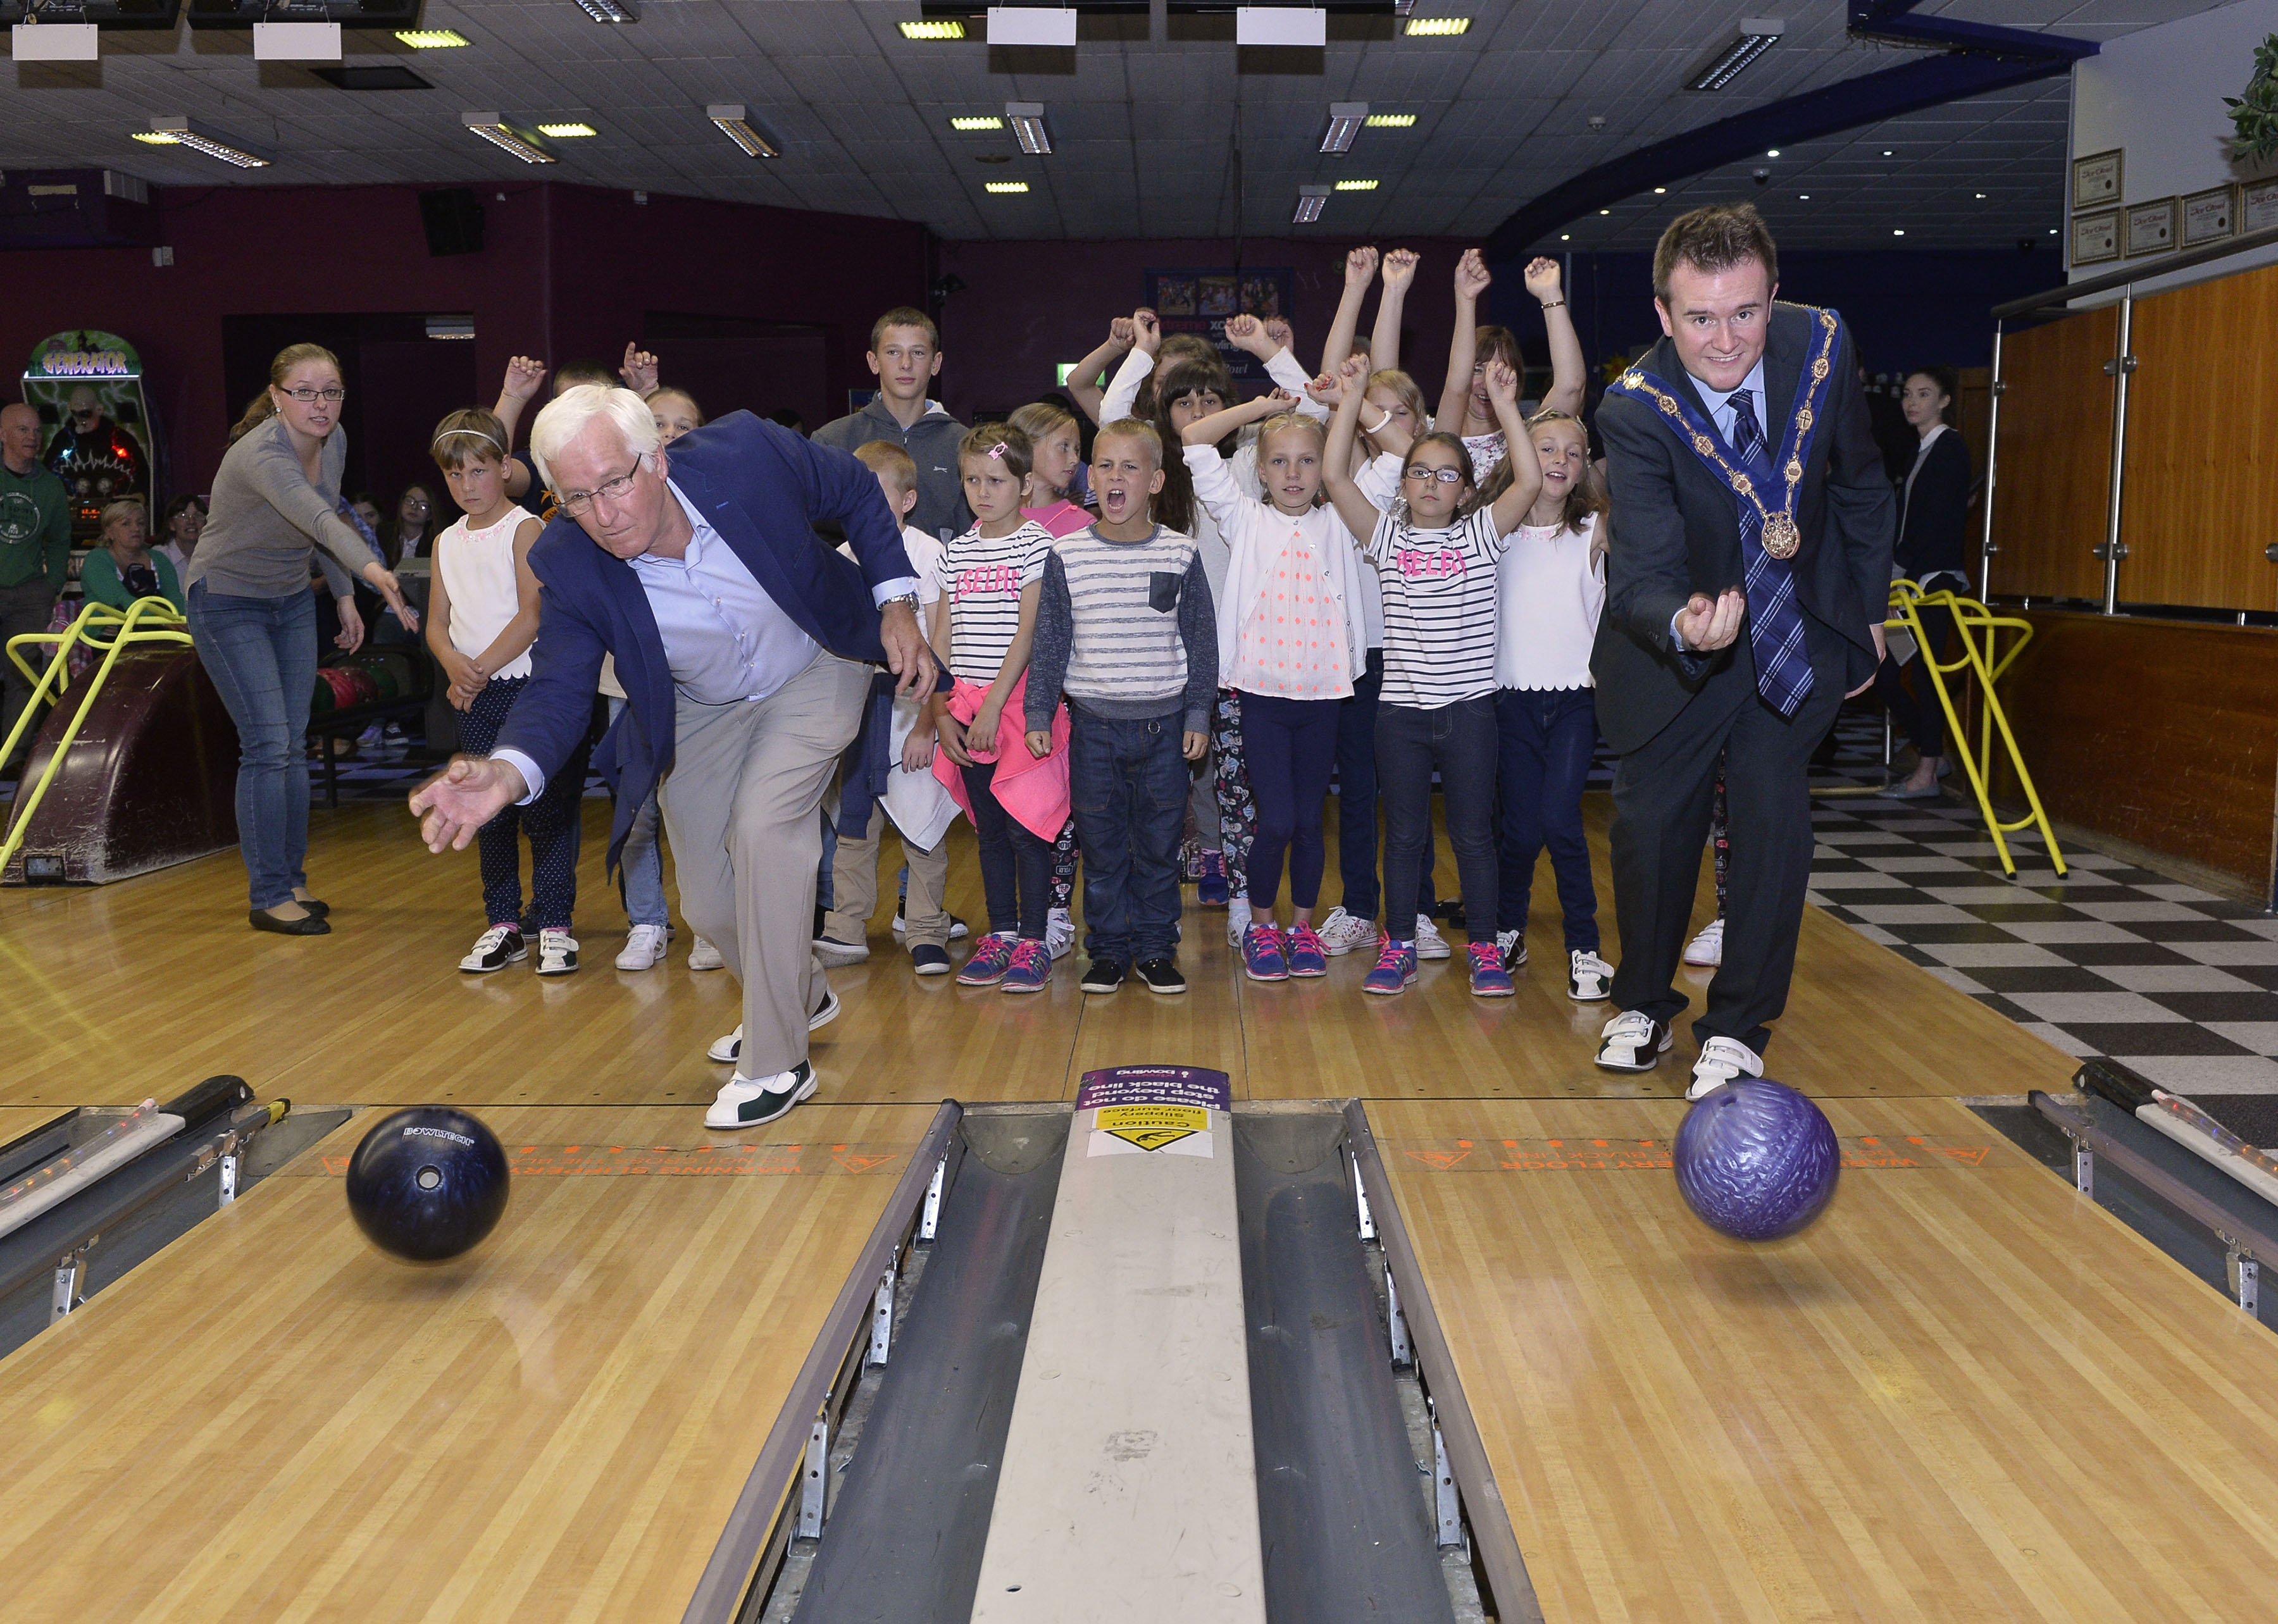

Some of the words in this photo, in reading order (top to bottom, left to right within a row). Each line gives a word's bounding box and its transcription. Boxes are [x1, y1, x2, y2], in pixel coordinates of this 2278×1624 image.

[42, 351, 128, 375] GENERATOR
[1088, 1082, 1123, 1091] line
[1187, 1084, 1220, 1094] the
[1092, 1088, 1166, 1098] beyond
[1171, 1089, 1215, 1100] step
[1083, 1097, 1117, 1106] not
[1152, 1096, 1221, 1110] Please
[1500, 1160, 1606, 1168] FLOOR
[509, 1167, 650, 1175] SLIPPERY
[657, 1165, 802, 1175] WARNING
